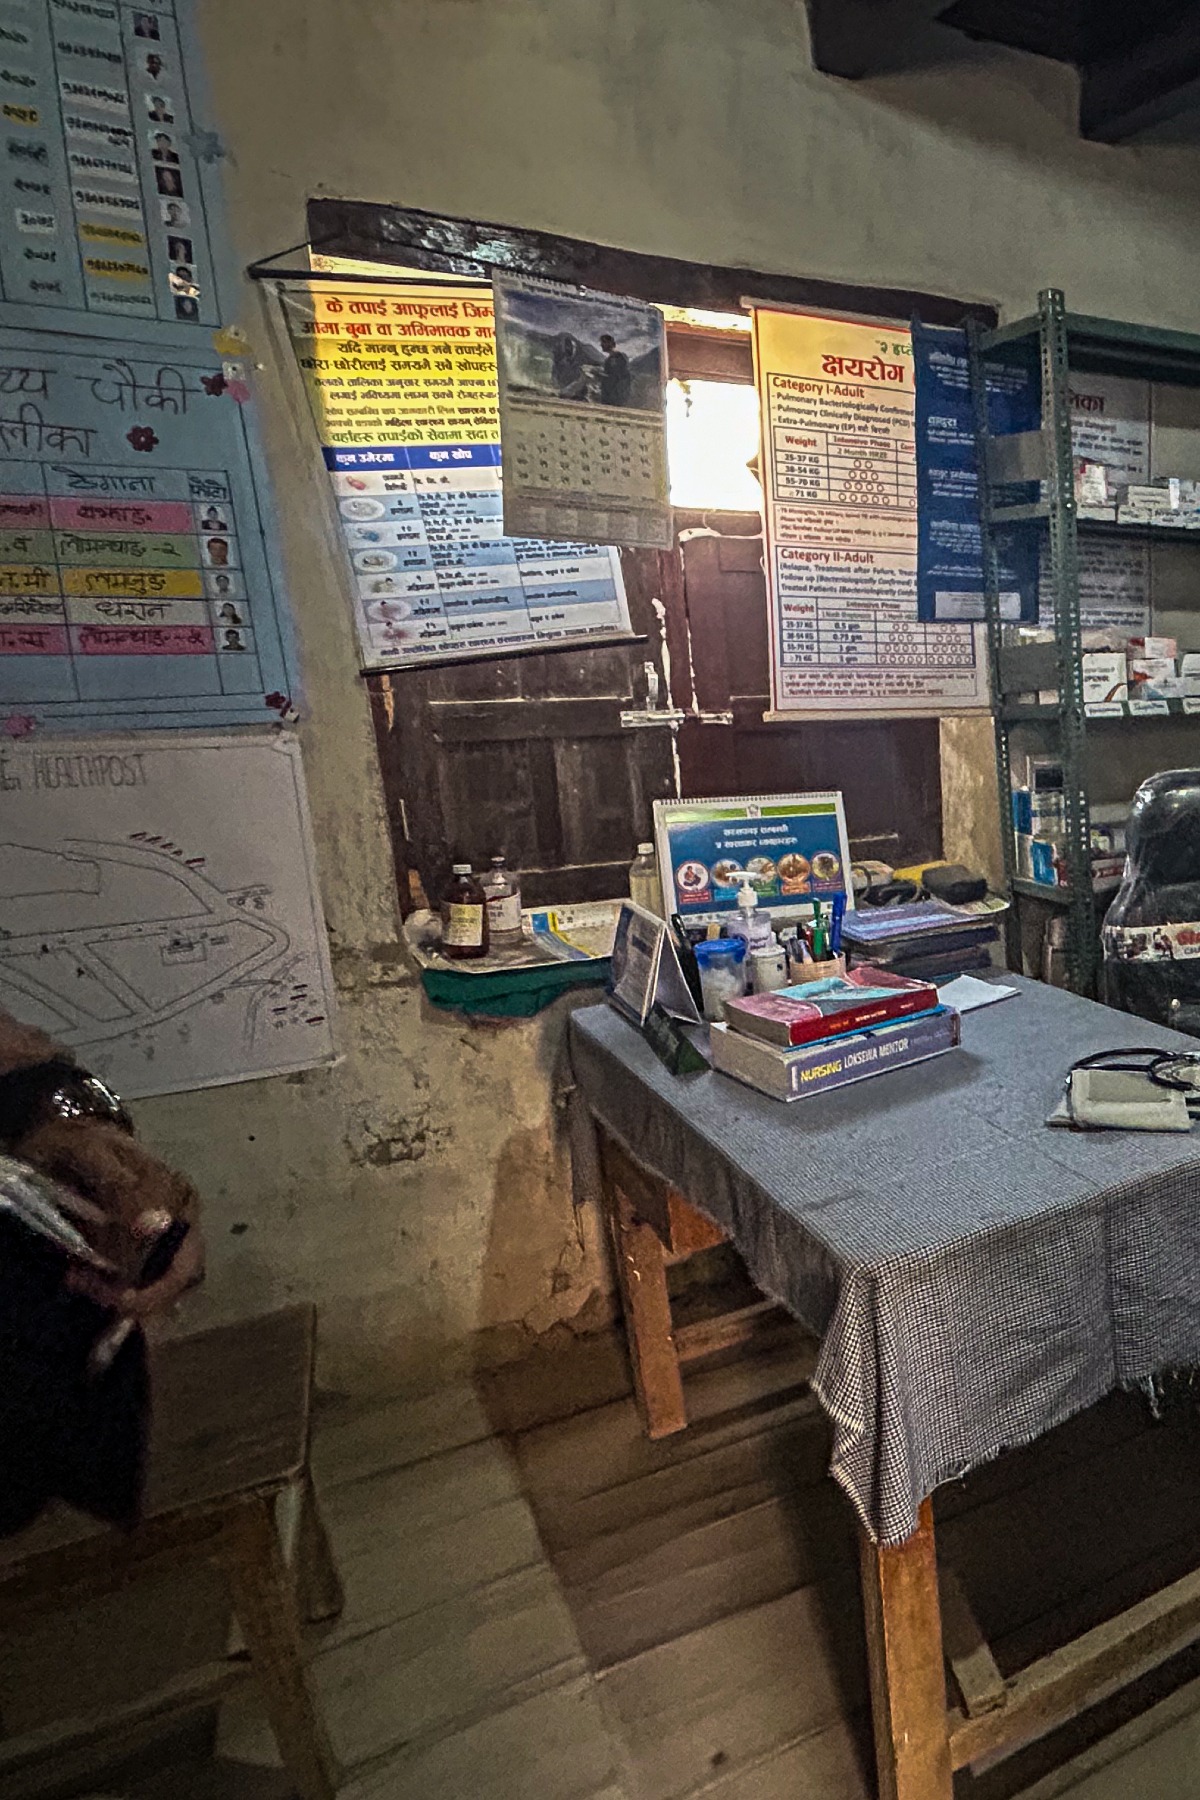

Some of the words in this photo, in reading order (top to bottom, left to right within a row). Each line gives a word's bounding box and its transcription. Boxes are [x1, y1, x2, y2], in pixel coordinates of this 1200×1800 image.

[324, 297, 343, 313] के
[376, 323, 392, 335] वा
[395, 321, 470, 337] अभिभावक
[336, 340, 361, 353] यदि
[821, 354, 905, 383] क्षयरोग
[772, 377, 823, 395] Category
[826, 385, 865, 398] I-Adult
[776, 392, 818, 406] Pulmonary
[819, 397, 879, 413] Bacteriologically
[777, 404, 818, 417] Pulmonary
[819, 410, 852, 423] Clinically
[853, 414, 891, 426] Diagnosed
[778, 416, 839, 430] Extra-Pulmonary
[785, 436, 817, 447] Weight
[870, 439, 891, 448] Phase
[809, 456, 820, 464] KG
[809, 479, 820, 487] KG
[781, 549, 830, 564] Category
[833, 551, 875, 564] II-Adult
[783, 603, 814, 614] Weight
[800, 1059, 842, 1083] NURSING
[878, 1037, 909, 1057] MENTOR
